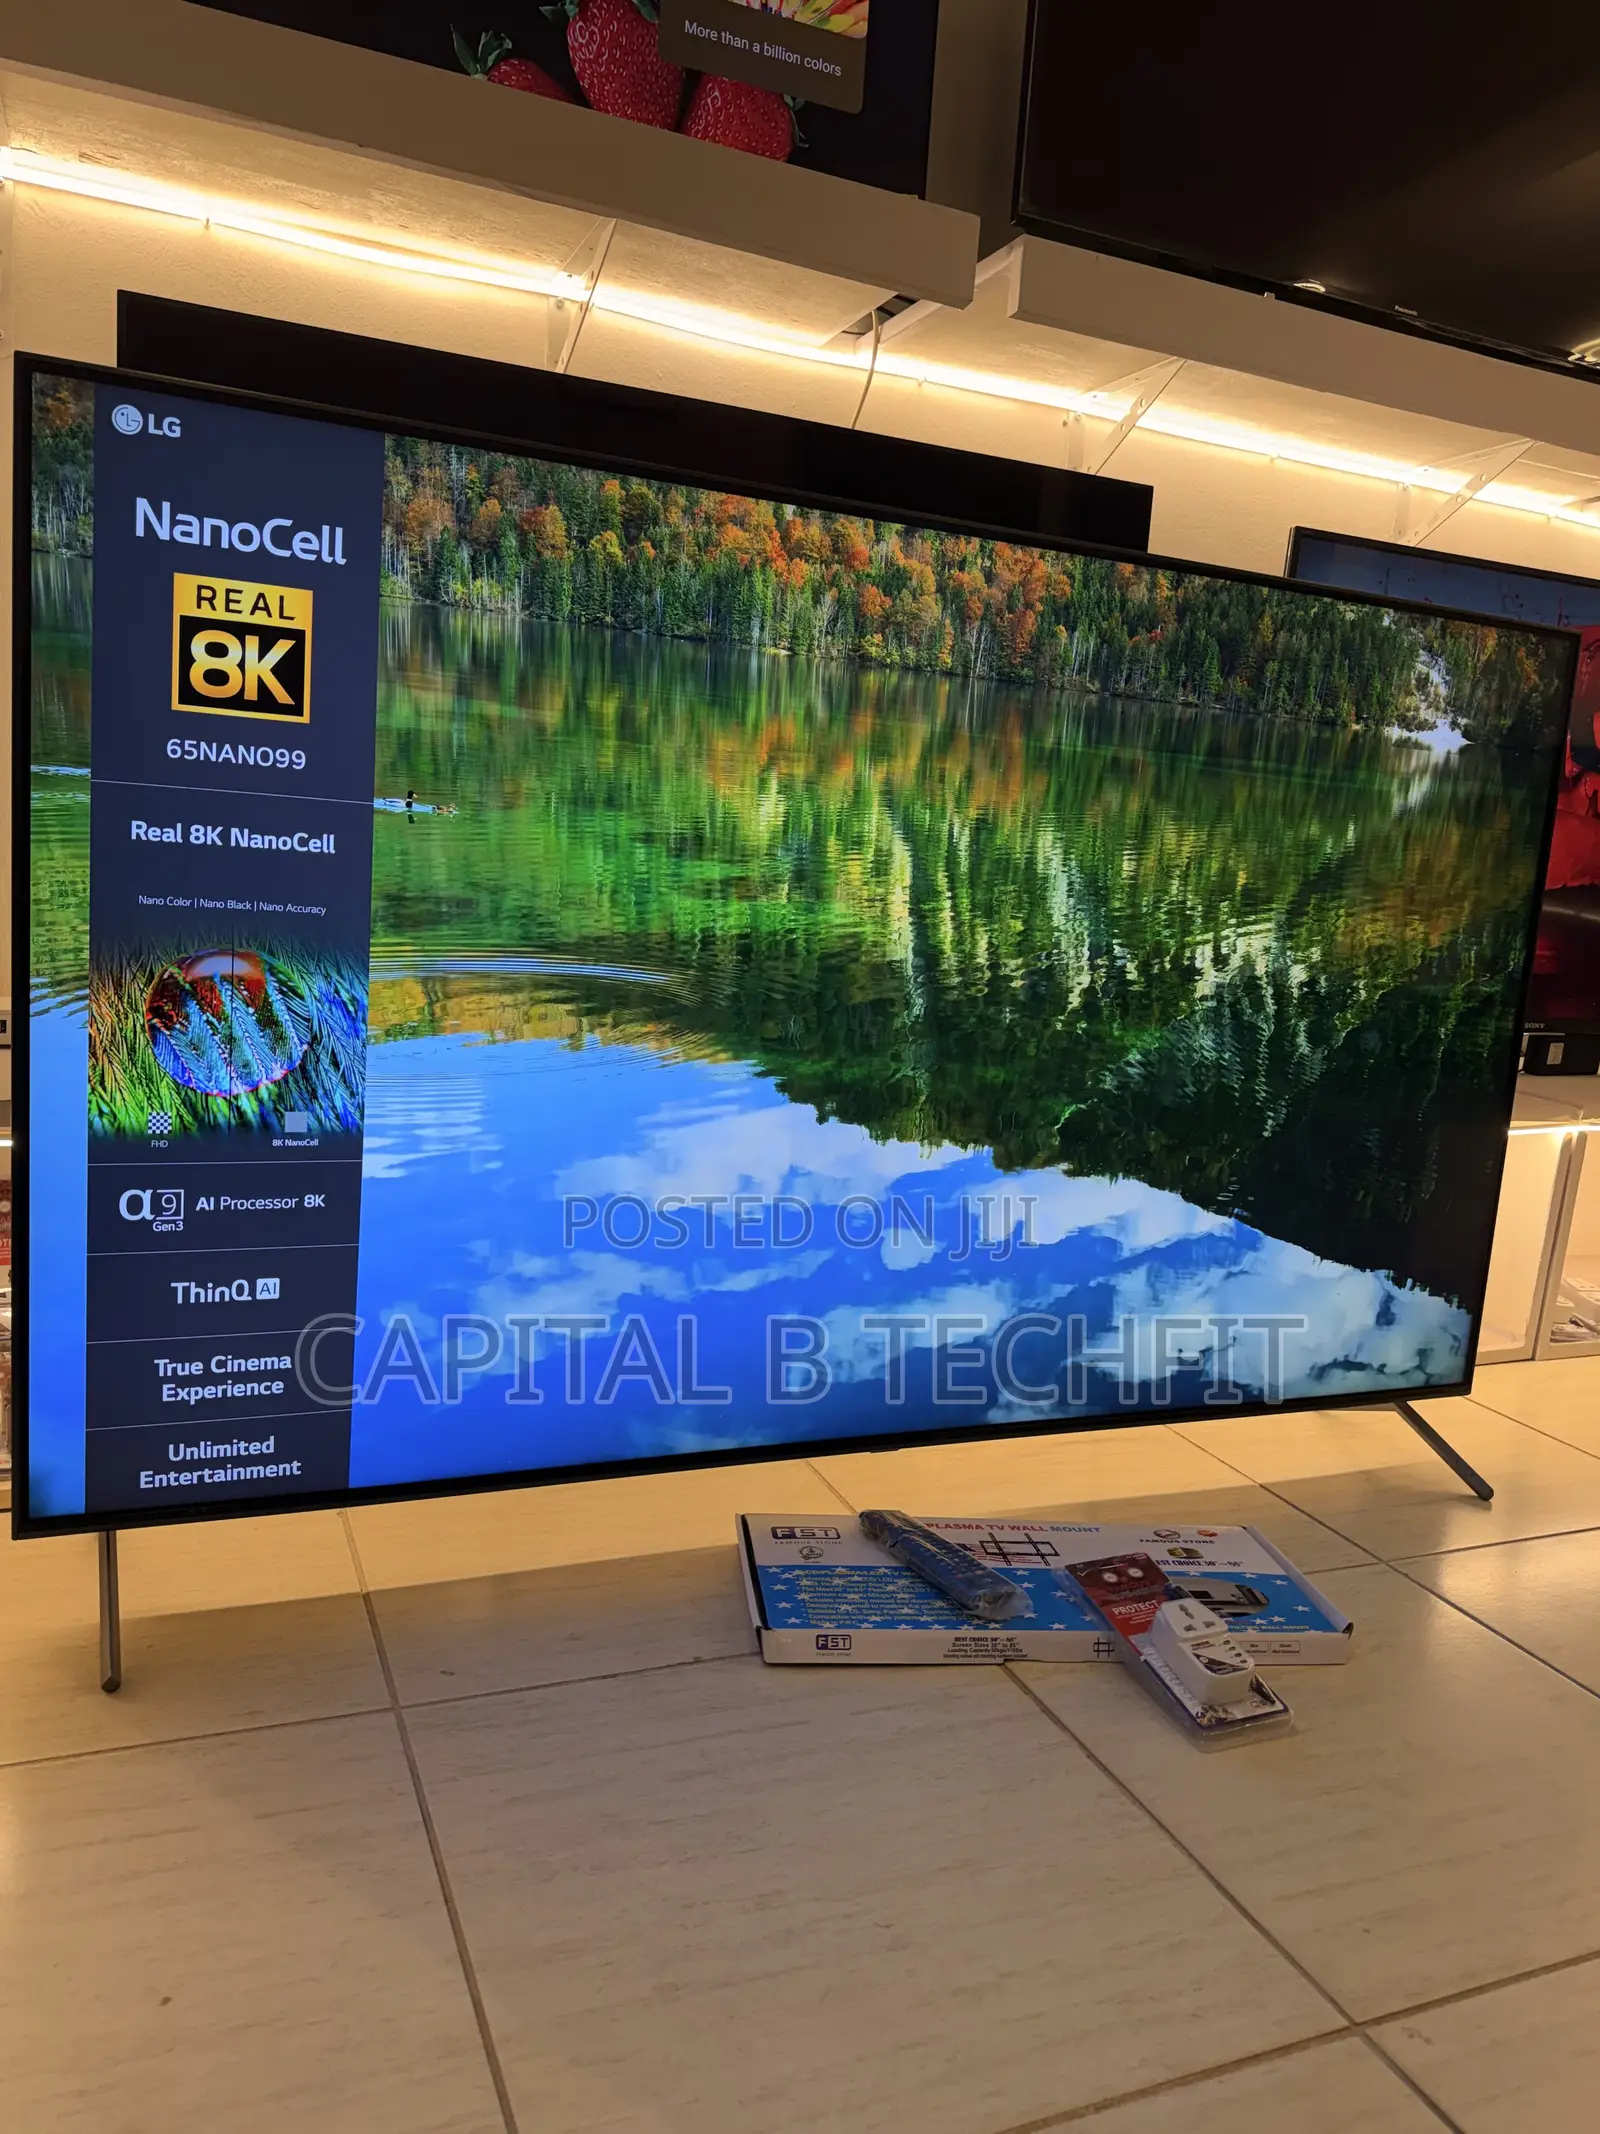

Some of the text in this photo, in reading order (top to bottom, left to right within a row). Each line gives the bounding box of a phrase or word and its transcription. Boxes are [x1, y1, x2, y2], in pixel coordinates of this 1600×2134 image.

[684, 19, 842, 76] More than a billion colors
[147, 413, 182, 438] LG
[134, 496, 348, 566] NanoCell
[195, 583, 297, 621] REAL
[189, 629, 297, 706] 8K
[166, 737, 307, 770] 65NANO99
[130, 819, 337, 854] Real 8K NanoCell
[138, 895, 327, 916] Nano Color Nano Black Nano Accuracy
[150, 1139, 169, 1149] FHD
[272, 1138, 319, 1148] 8K NanoCell
[195, 1194, 326, 1212] AI Processor 8K
[152, 1221, 184, 1232] Gen3
[170, 1279, 279, 1305] ThinQ AI
[154, 1354, 293, 1377] True Cinema
[162, 1379, 285, 1405] Experience
[168, 1435, 275, 1462] Unlimited
[139, 1460, 302, 1489] Entertainment
[773, 1527, 838, 1539] FST
[925, 1523, 984, 1531] PLASMA
[1008, 1524, 1049, 1532] WALL
[1111, 1600, 1159, 1615] PROTECT
[817, 1635, 851, 1649] FST
